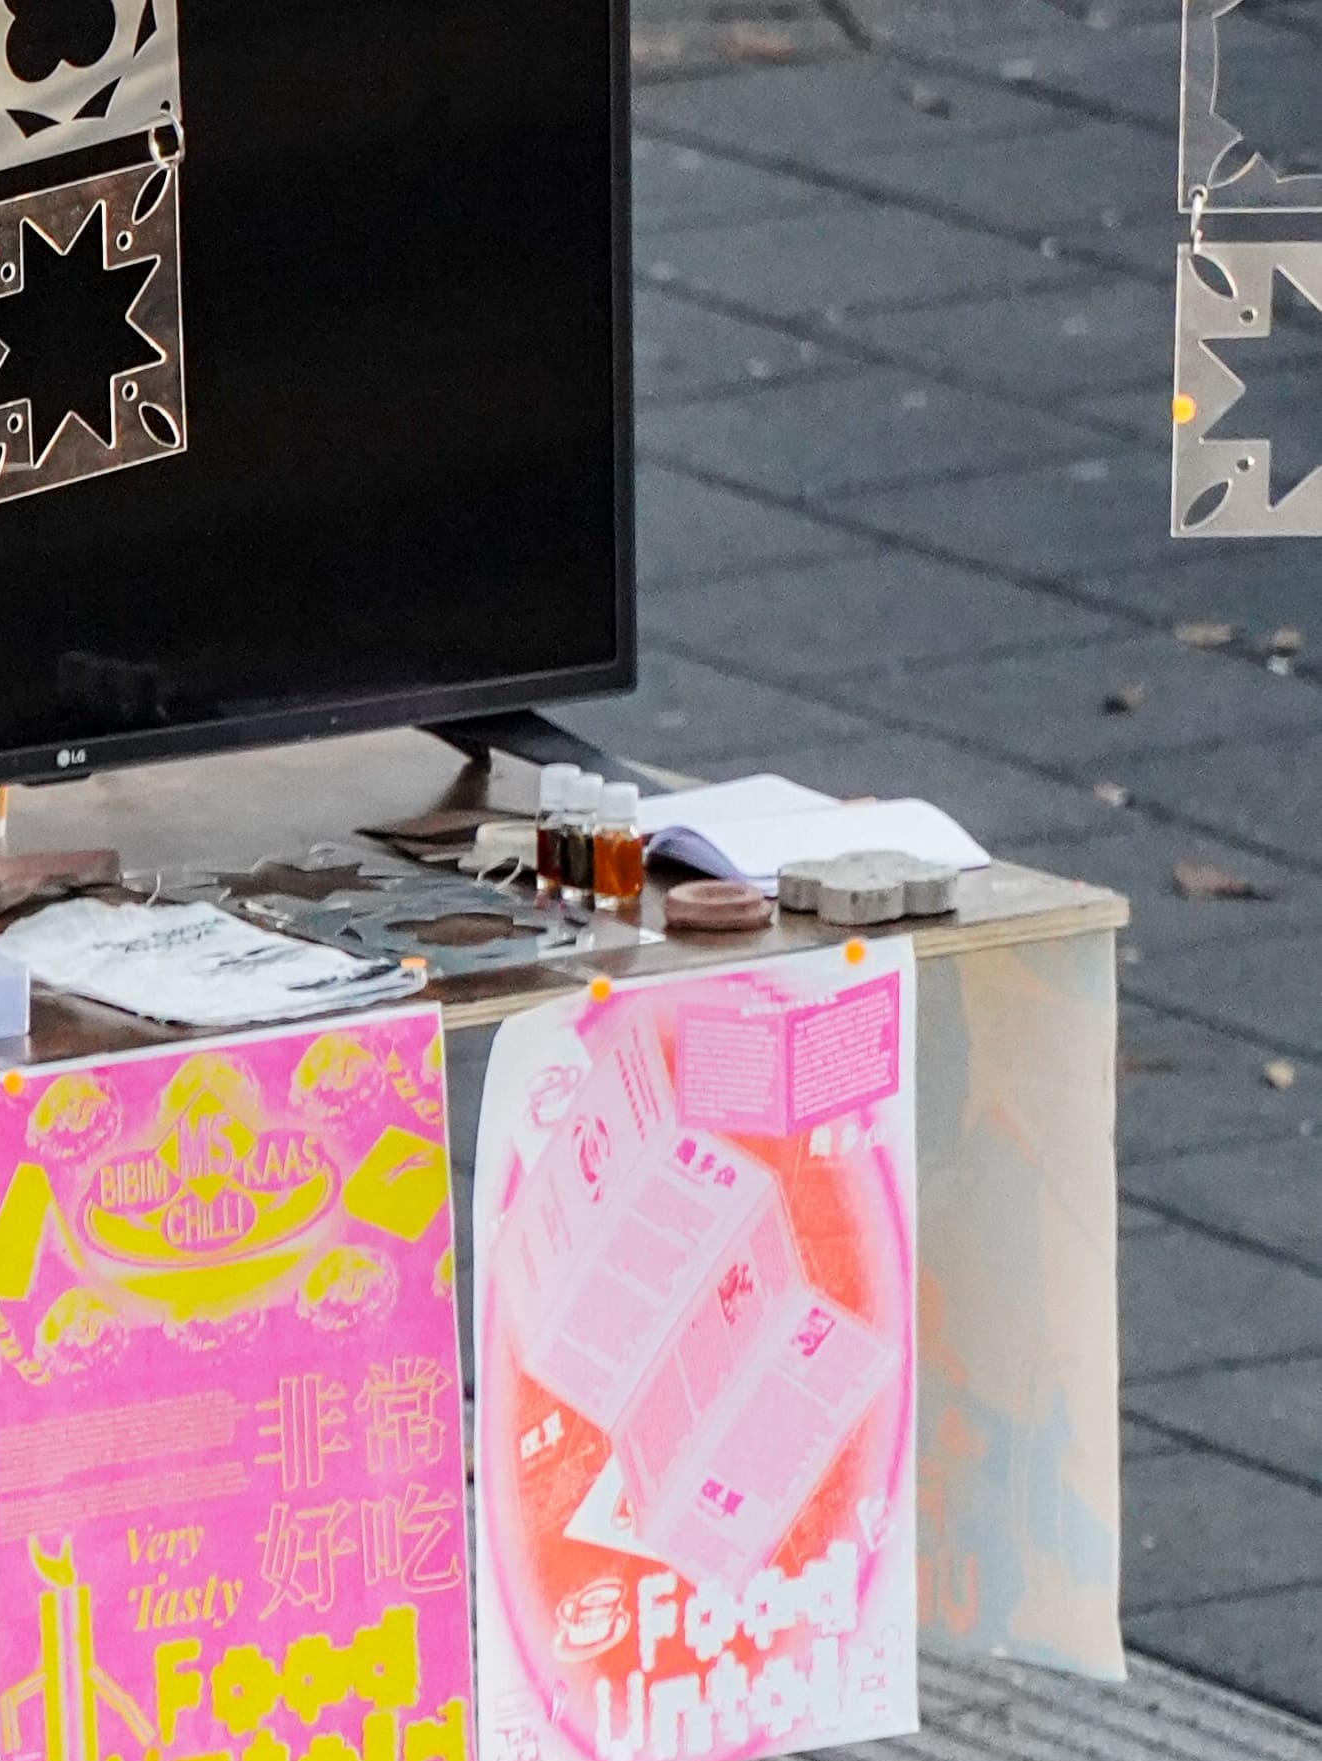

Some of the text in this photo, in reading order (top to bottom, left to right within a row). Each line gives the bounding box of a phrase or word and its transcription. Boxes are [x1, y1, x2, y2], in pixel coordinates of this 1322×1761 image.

[72, 749, 85, 763] LG
[100, 1137, 317, 1208] BIBIM KAAS
[179, 1114, 232, 1178] MS
[167, 1196, 245, 1246] CHILLI
[254, 1357, 453, 1491] 非常
[126, 1526, 203, 1567] Very
[258, 1483, 463, 1621] 好吃
[126, 1578, 242, 1630] Tasty
[637, 1541, 857, 1673] Food
[156, 1604, 419, 1745] Food
